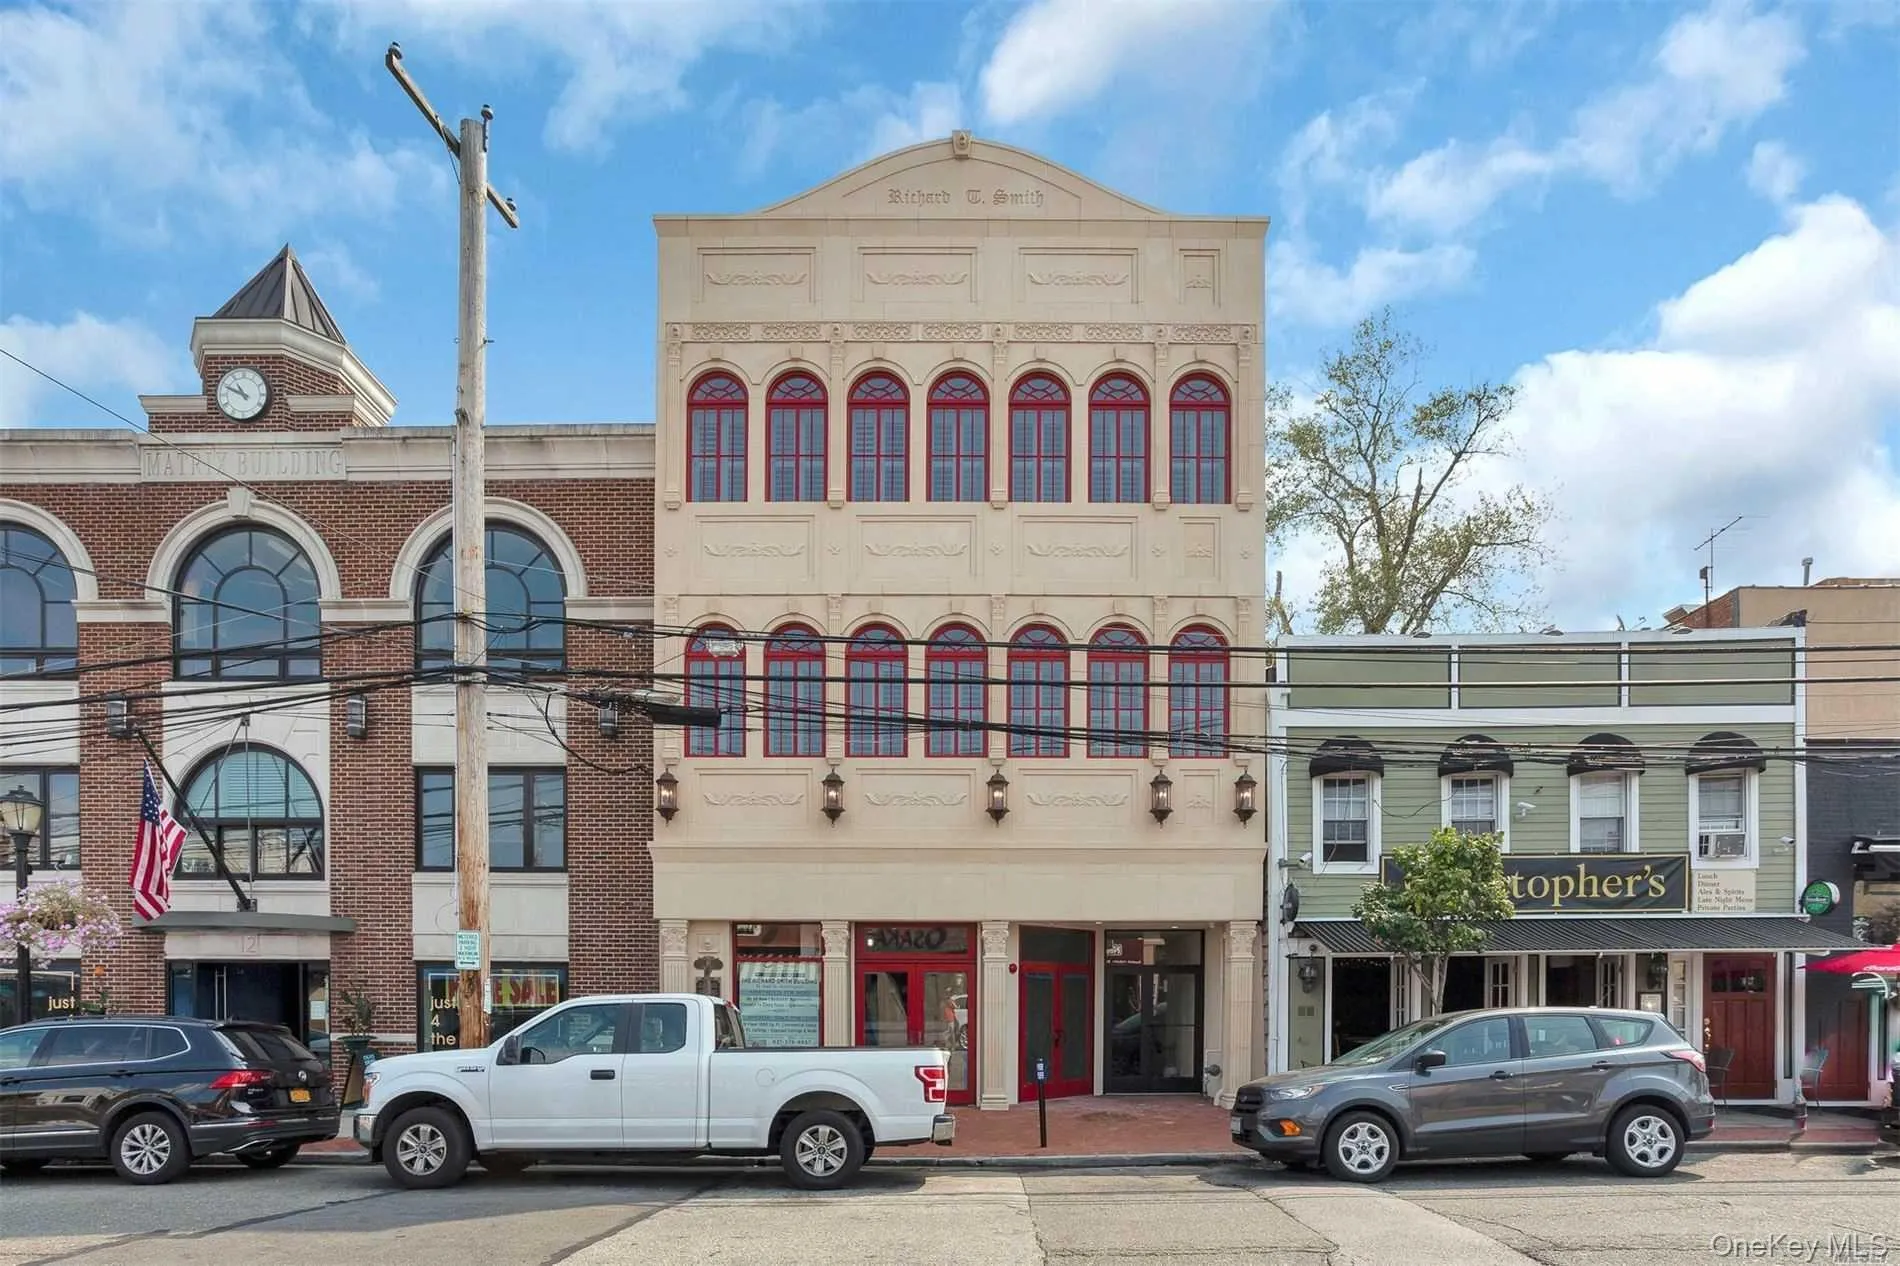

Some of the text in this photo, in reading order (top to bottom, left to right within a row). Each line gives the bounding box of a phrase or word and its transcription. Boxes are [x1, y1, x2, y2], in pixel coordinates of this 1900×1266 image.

[887, 188, 951, 207] Richard
[992, 188, 1044, 208] Smith
[238, 450, 342, 476] BUILDING
[1697, 871, 1719, 880] Lunch
[1508, 863, 1666, 907] topher's
[510, 979, 558, 1004] SALE
[47, 995, 76, 1012] just
[430, 996, 458, 1011] just
[430, 1014, 441, 1027] 4
[430, 1032, 456, 1045] the
